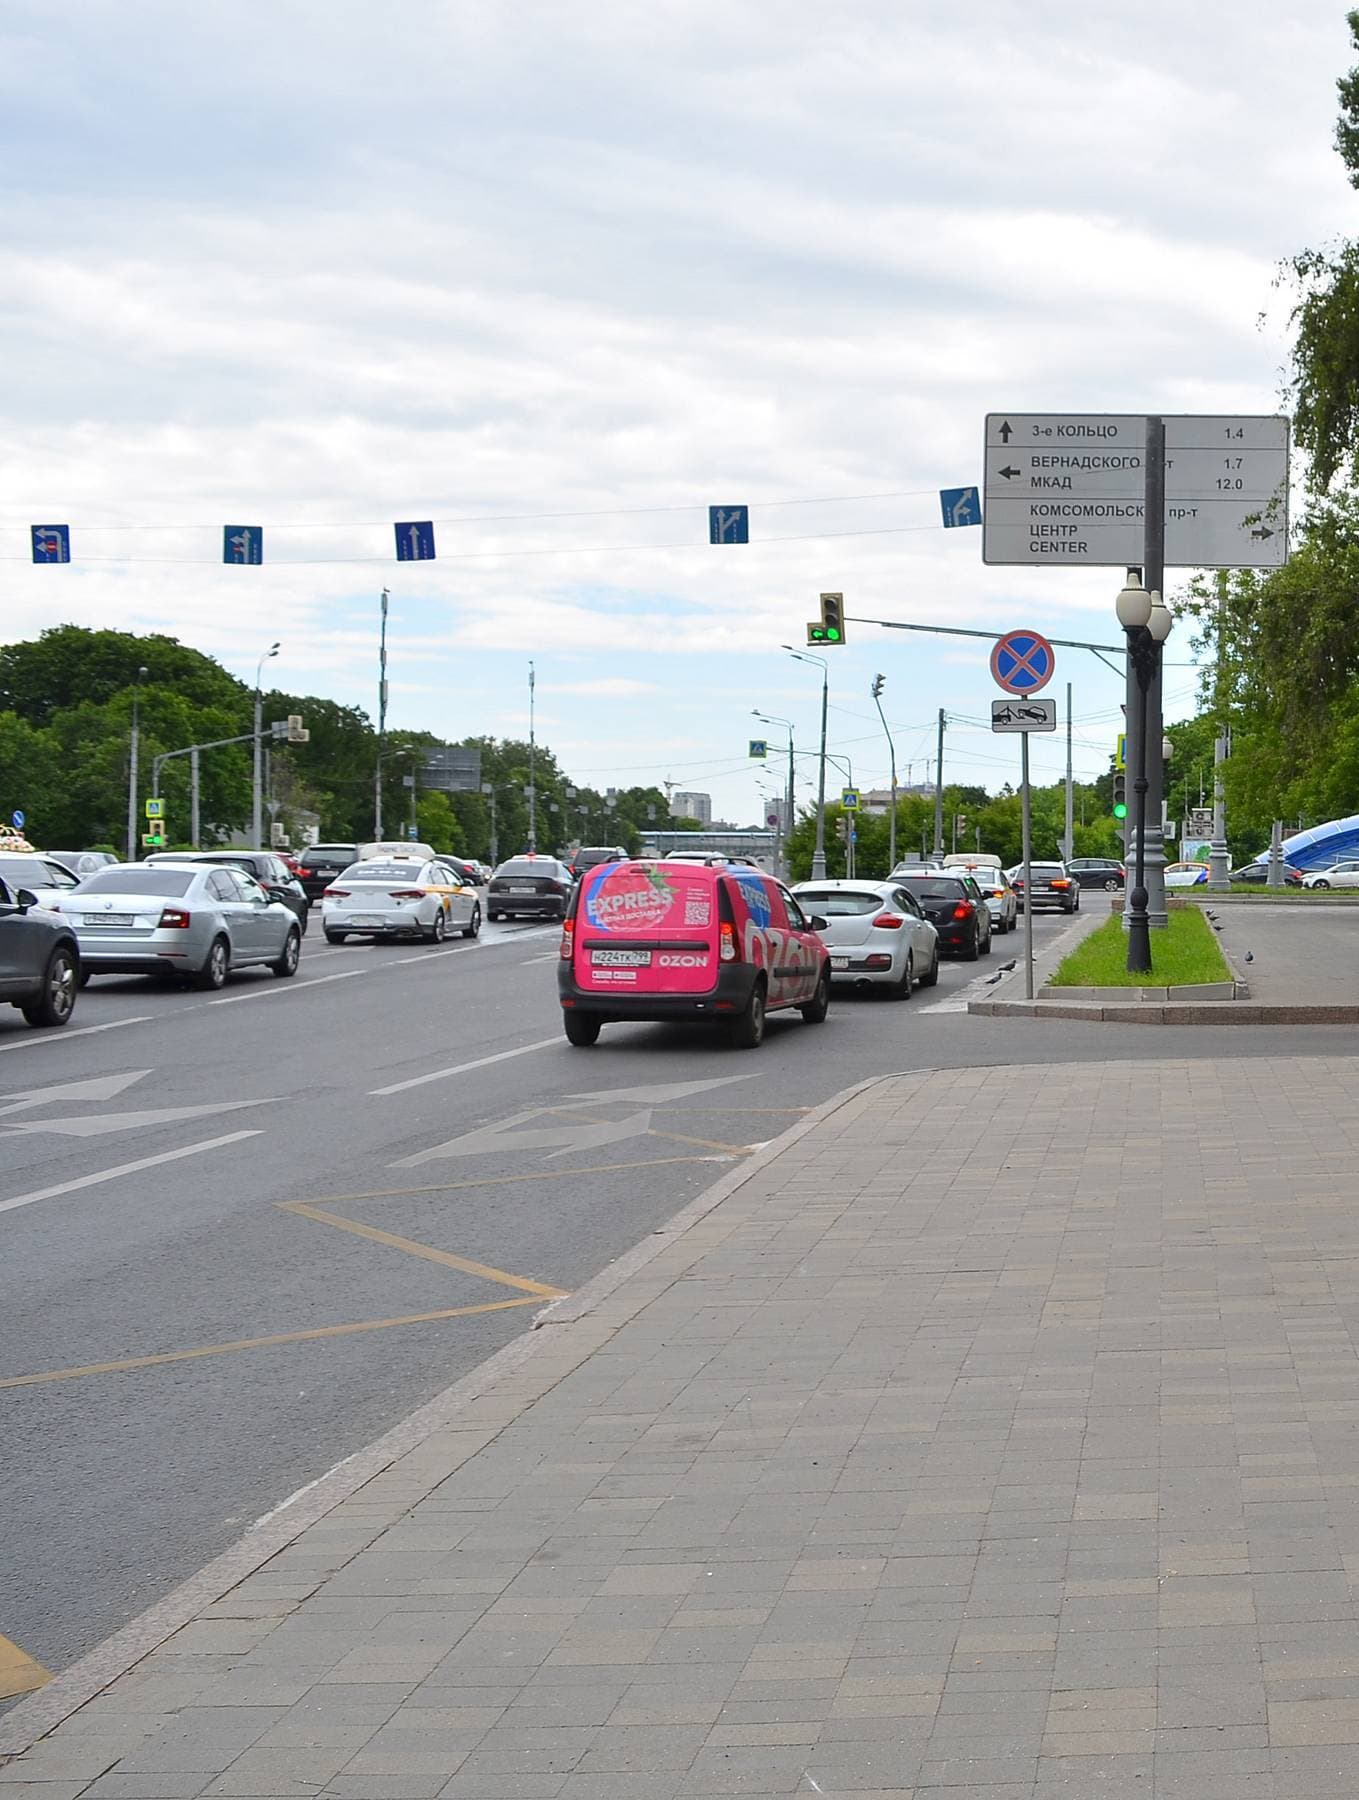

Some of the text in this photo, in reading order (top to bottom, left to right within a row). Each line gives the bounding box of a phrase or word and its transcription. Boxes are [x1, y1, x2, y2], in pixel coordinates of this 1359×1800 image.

[1032, 425, 1244, 439] 3-е КОЛЬЦО 1.4
[1031, 456, 1140, 469] ВЕРНАДСКОГО
[1224, 458, 1243, 470] 1.7
[1030, 476, 1243, 490] МКАД 12.0
[1030, 504, 1198, 520] КОМСОМОЛЬСК пр-т
[1030, 525, 1078, 538] ЦЕНТР
[1029, 541, 1088, 553] CENTER
[587, 888, 675, 915] EXPRESS
[659, 955, 707, 967] OZON
